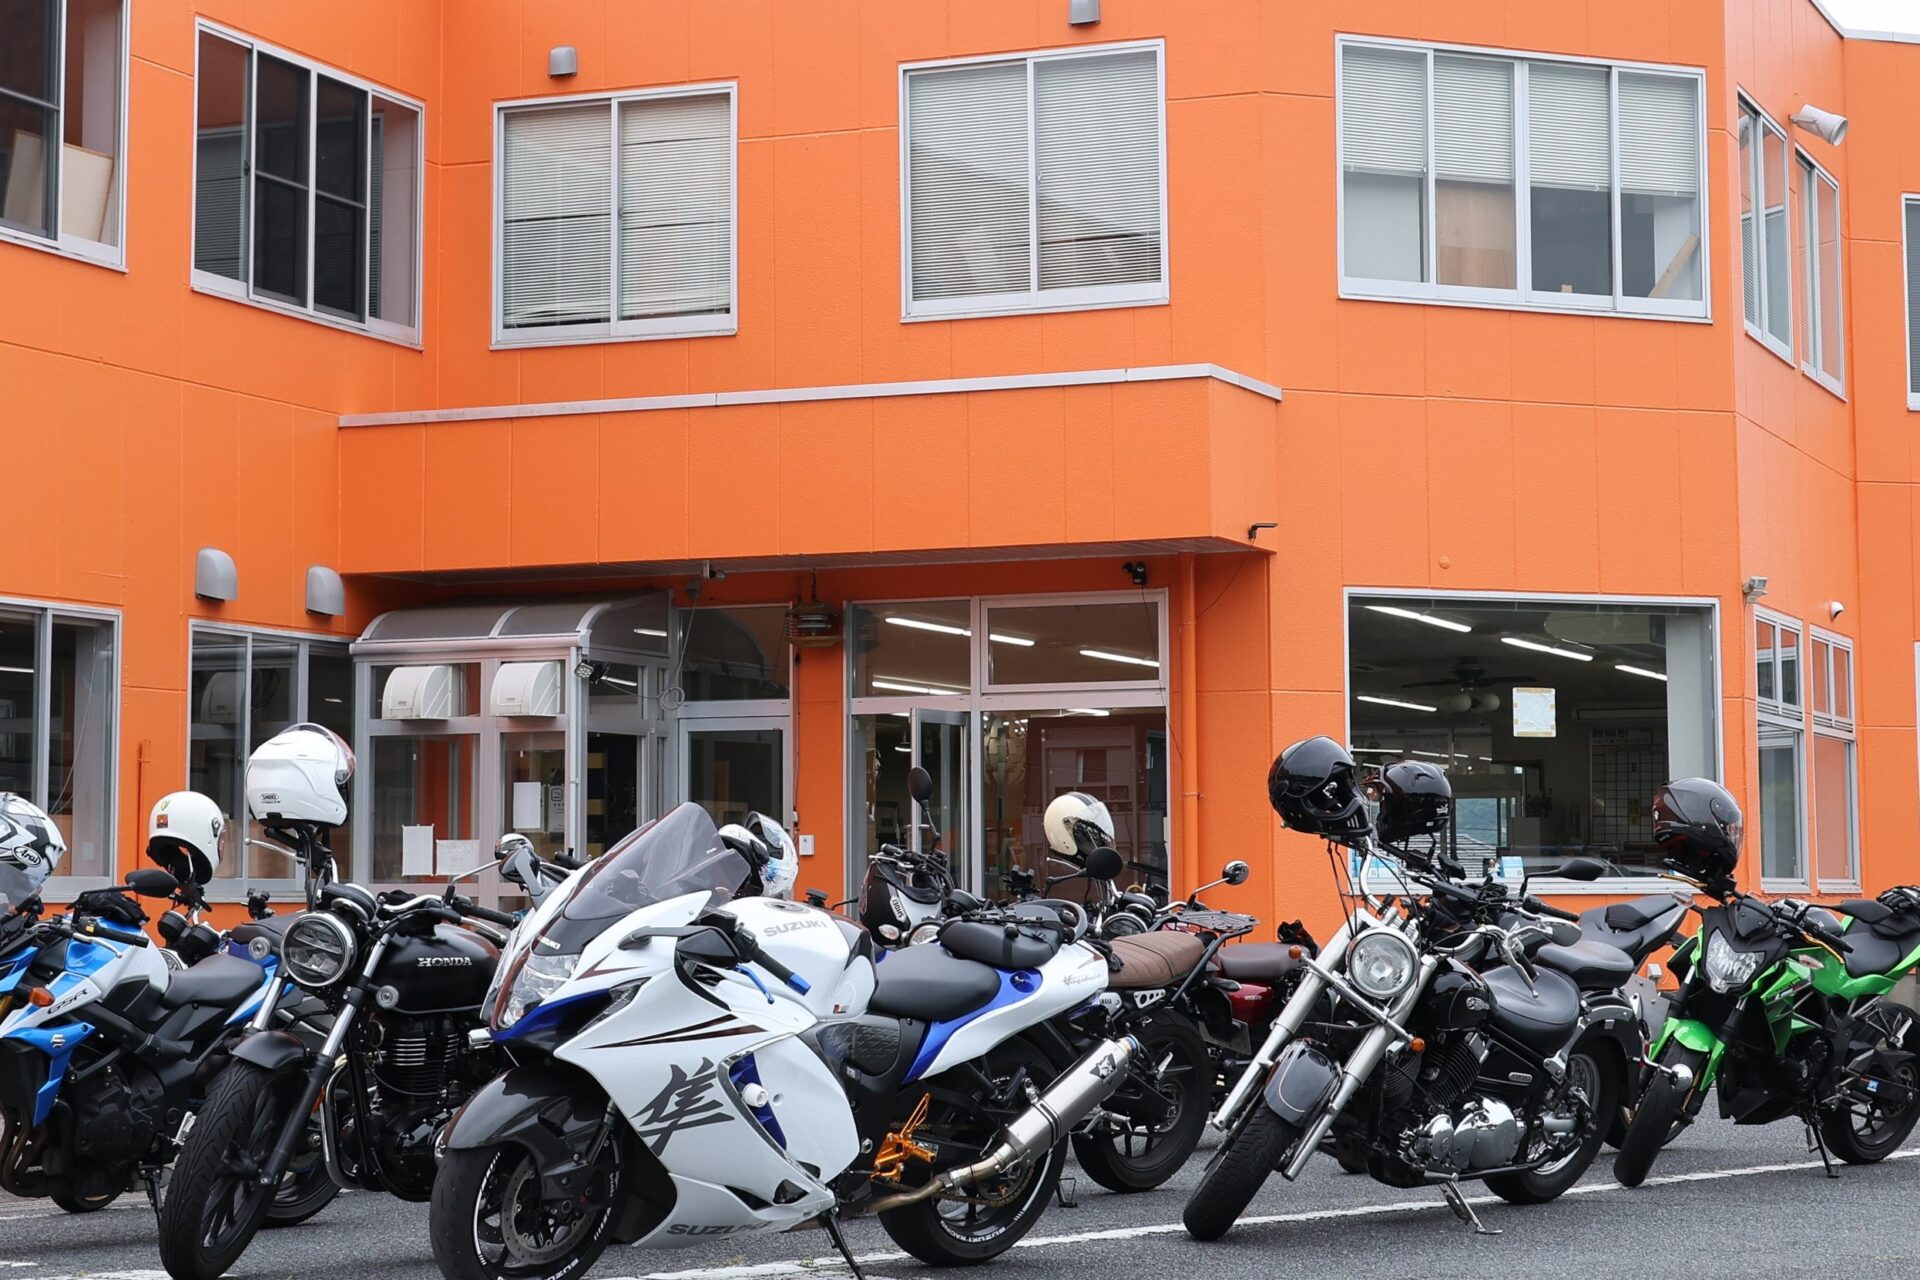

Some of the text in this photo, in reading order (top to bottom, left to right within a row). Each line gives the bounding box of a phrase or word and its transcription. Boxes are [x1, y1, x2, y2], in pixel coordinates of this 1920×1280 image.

[16, 849, 39, 863] Arai
[763, 920, 828, 937] SUZUKI
[417, 956, 472, 967] HONDA
[629, 1056, 736, 1157] 隼
[667, 1220, 773, 1236] SUZUKI
